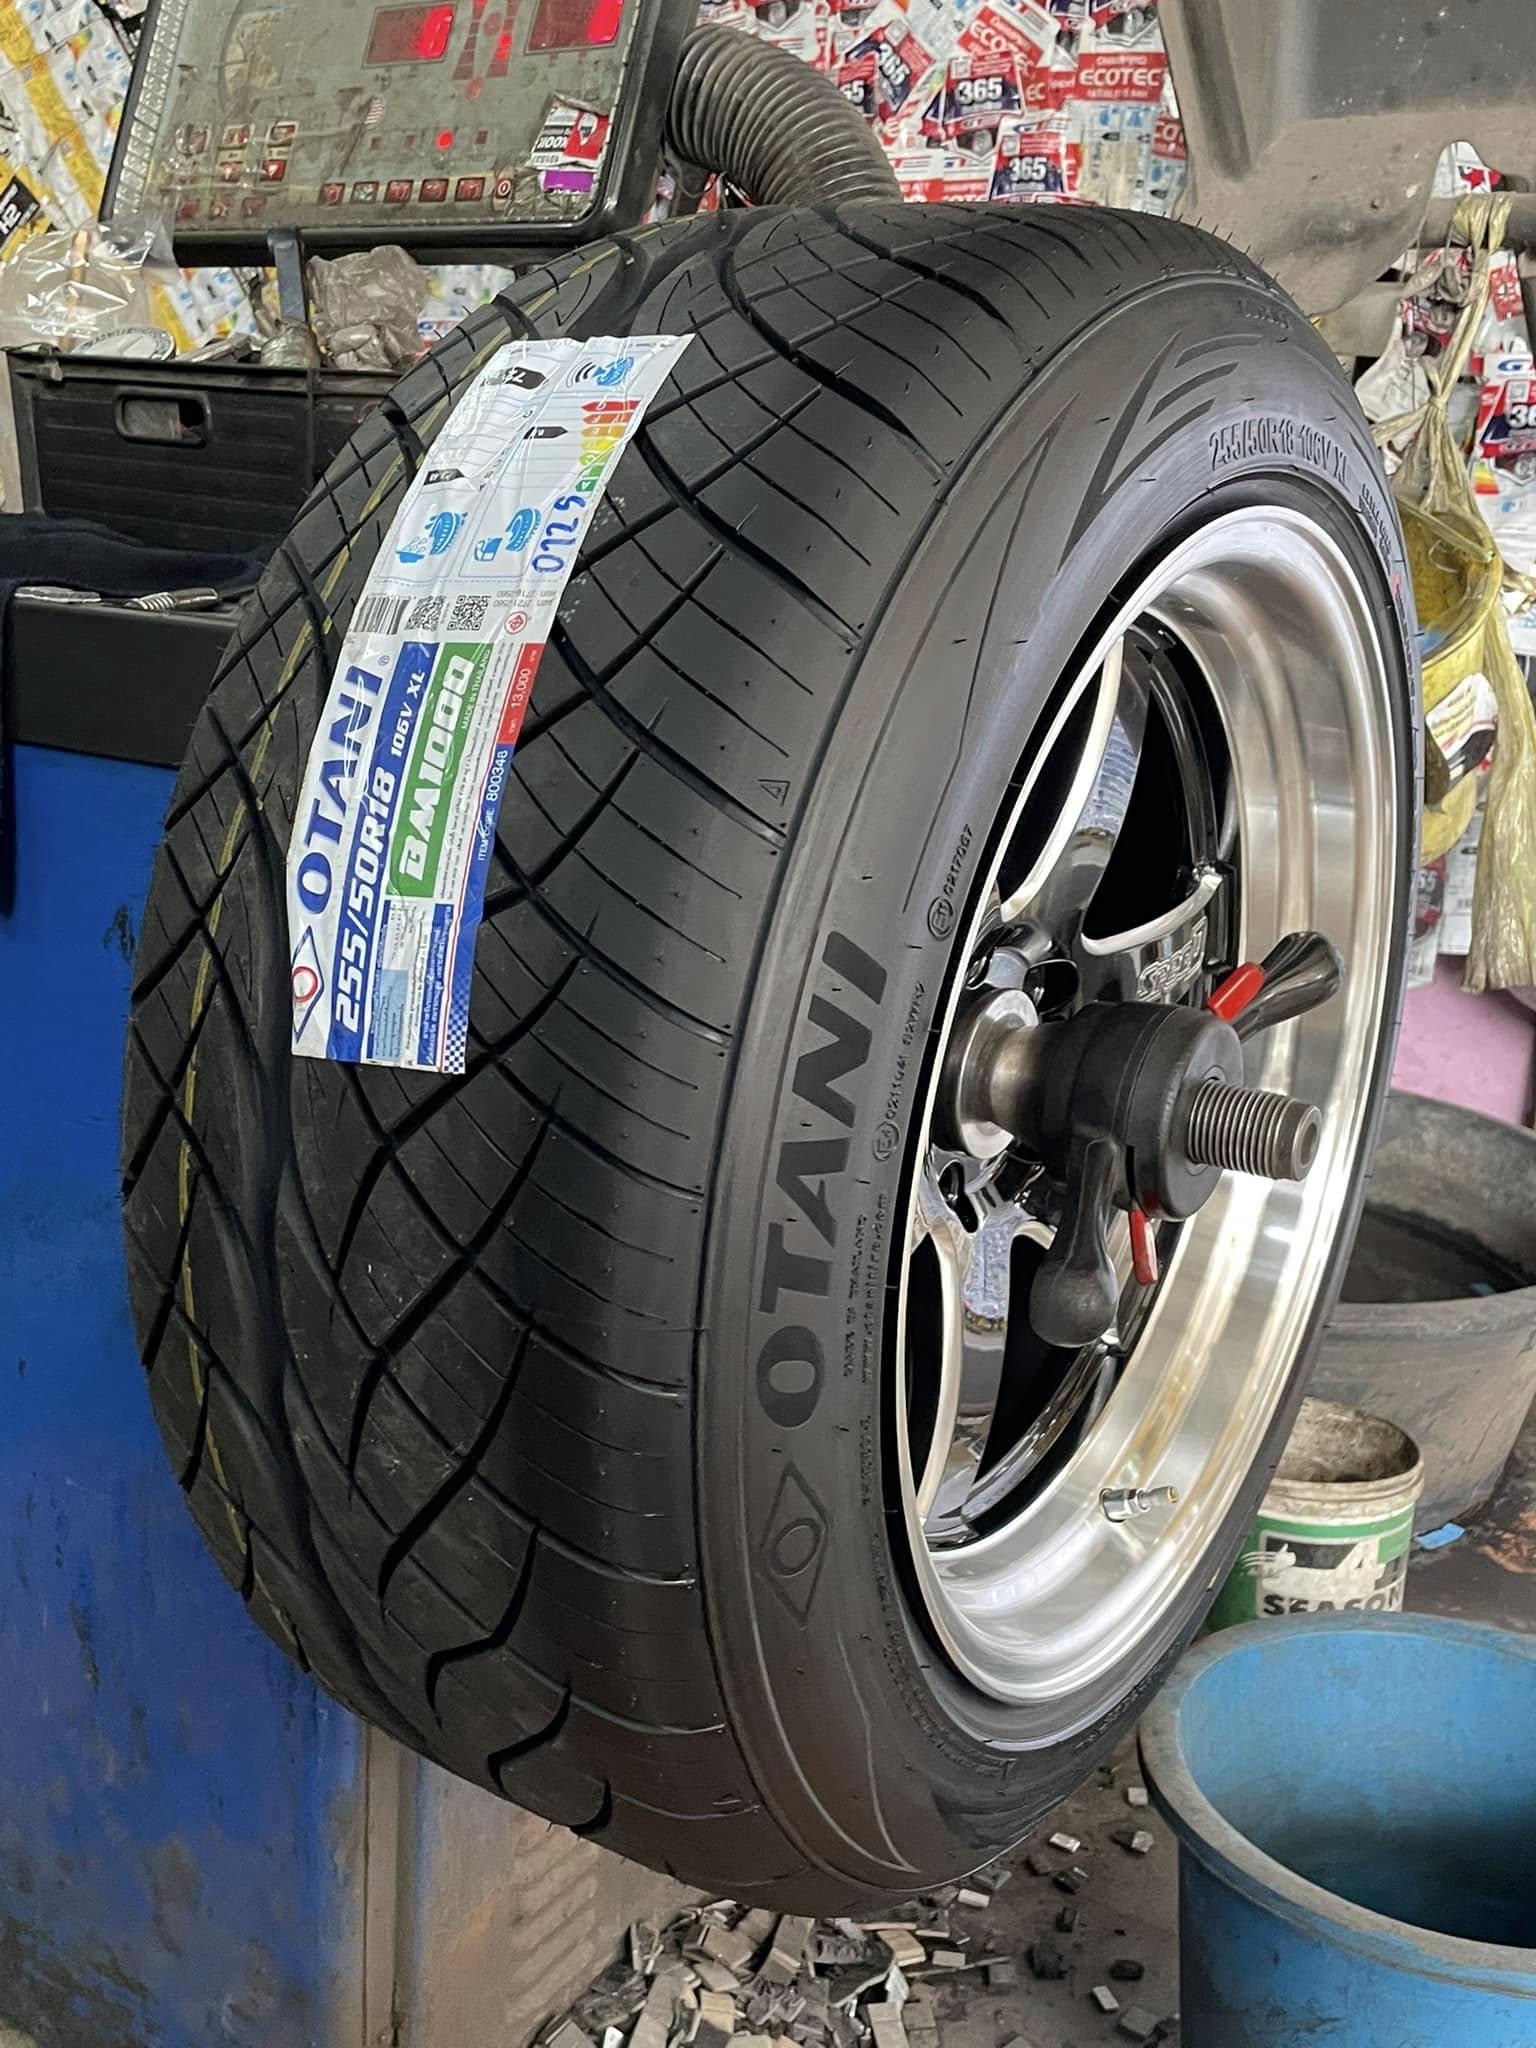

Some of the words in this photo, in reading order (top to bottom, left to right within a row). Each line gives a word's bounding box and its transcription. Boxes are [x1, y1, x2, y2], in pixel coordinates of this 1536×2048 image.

[957, 77, 1003, 105] 365
[1079, 68, 1162, 87] ECOTEC
[1008, 156, 1048, 182] 365
[297, 665, 384, 915] OTANI
[400, 655, 475, 881] BM1000
[486, 750, 508, 802] 800348
[334, 766, 396, 1034] 255/50R18
[391, 702, 413, 758] 106V
[406, 671, 425, 699] XL
[756, 929, 888, 1429] OTANI
